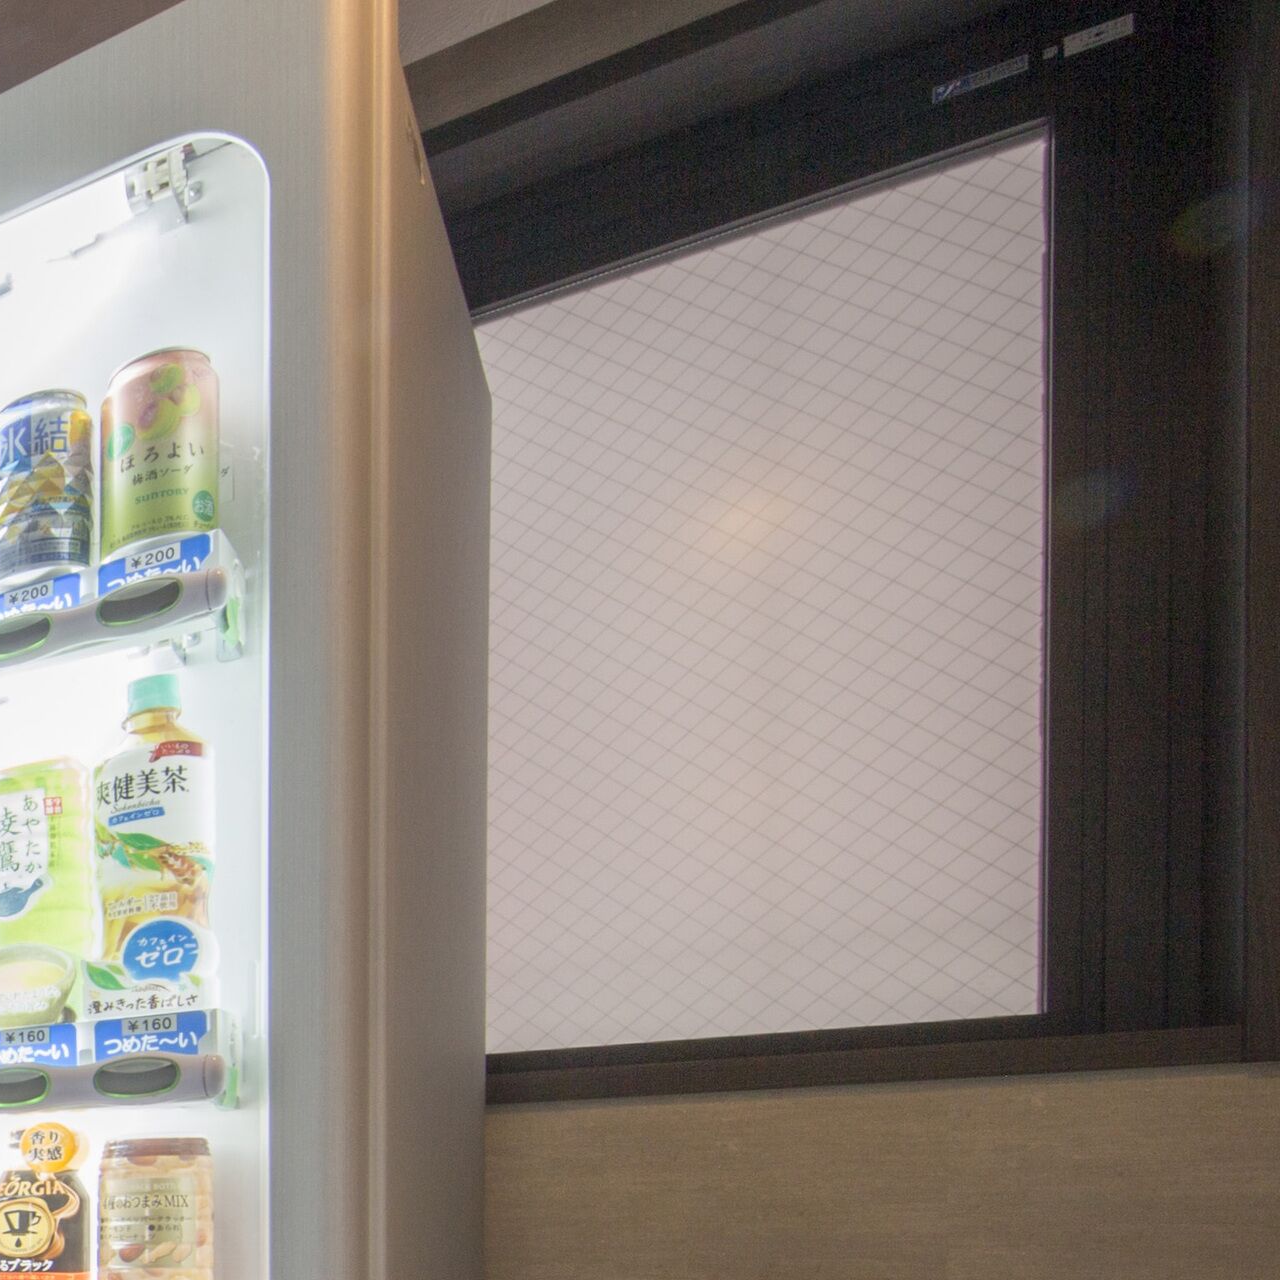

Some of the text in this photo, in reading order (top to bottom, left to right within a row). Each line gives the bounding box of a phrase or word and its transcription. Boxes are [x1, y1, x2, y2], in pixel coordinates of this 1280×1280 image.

[0, 416, 69, 465] 氷結
[120, 441, 204, 473] ほろよい
[135, 488, 190, 505] SUNTORY
[131, 547, 175, 568] ¥200
[8, 585, 49, 604] ¥200
[97, 765, 188, 808] 爽健美茶
[111, 809, 160, 824] カフェインゼロ
[22, 795, 42, 875] あやたか
[137, 934, 187, 947] カフェイン
[136, 945, 185, 969] ゼロ
[87, 992, 198, 1015] 澄みきった香ばしさ
[128, 1016, 172, 1032] ¥160
[6, 1030, 45, 1043] ¥160
[30, 1130, 59, 1144] 香り
[29, 1146, 63, 1161] 実感
